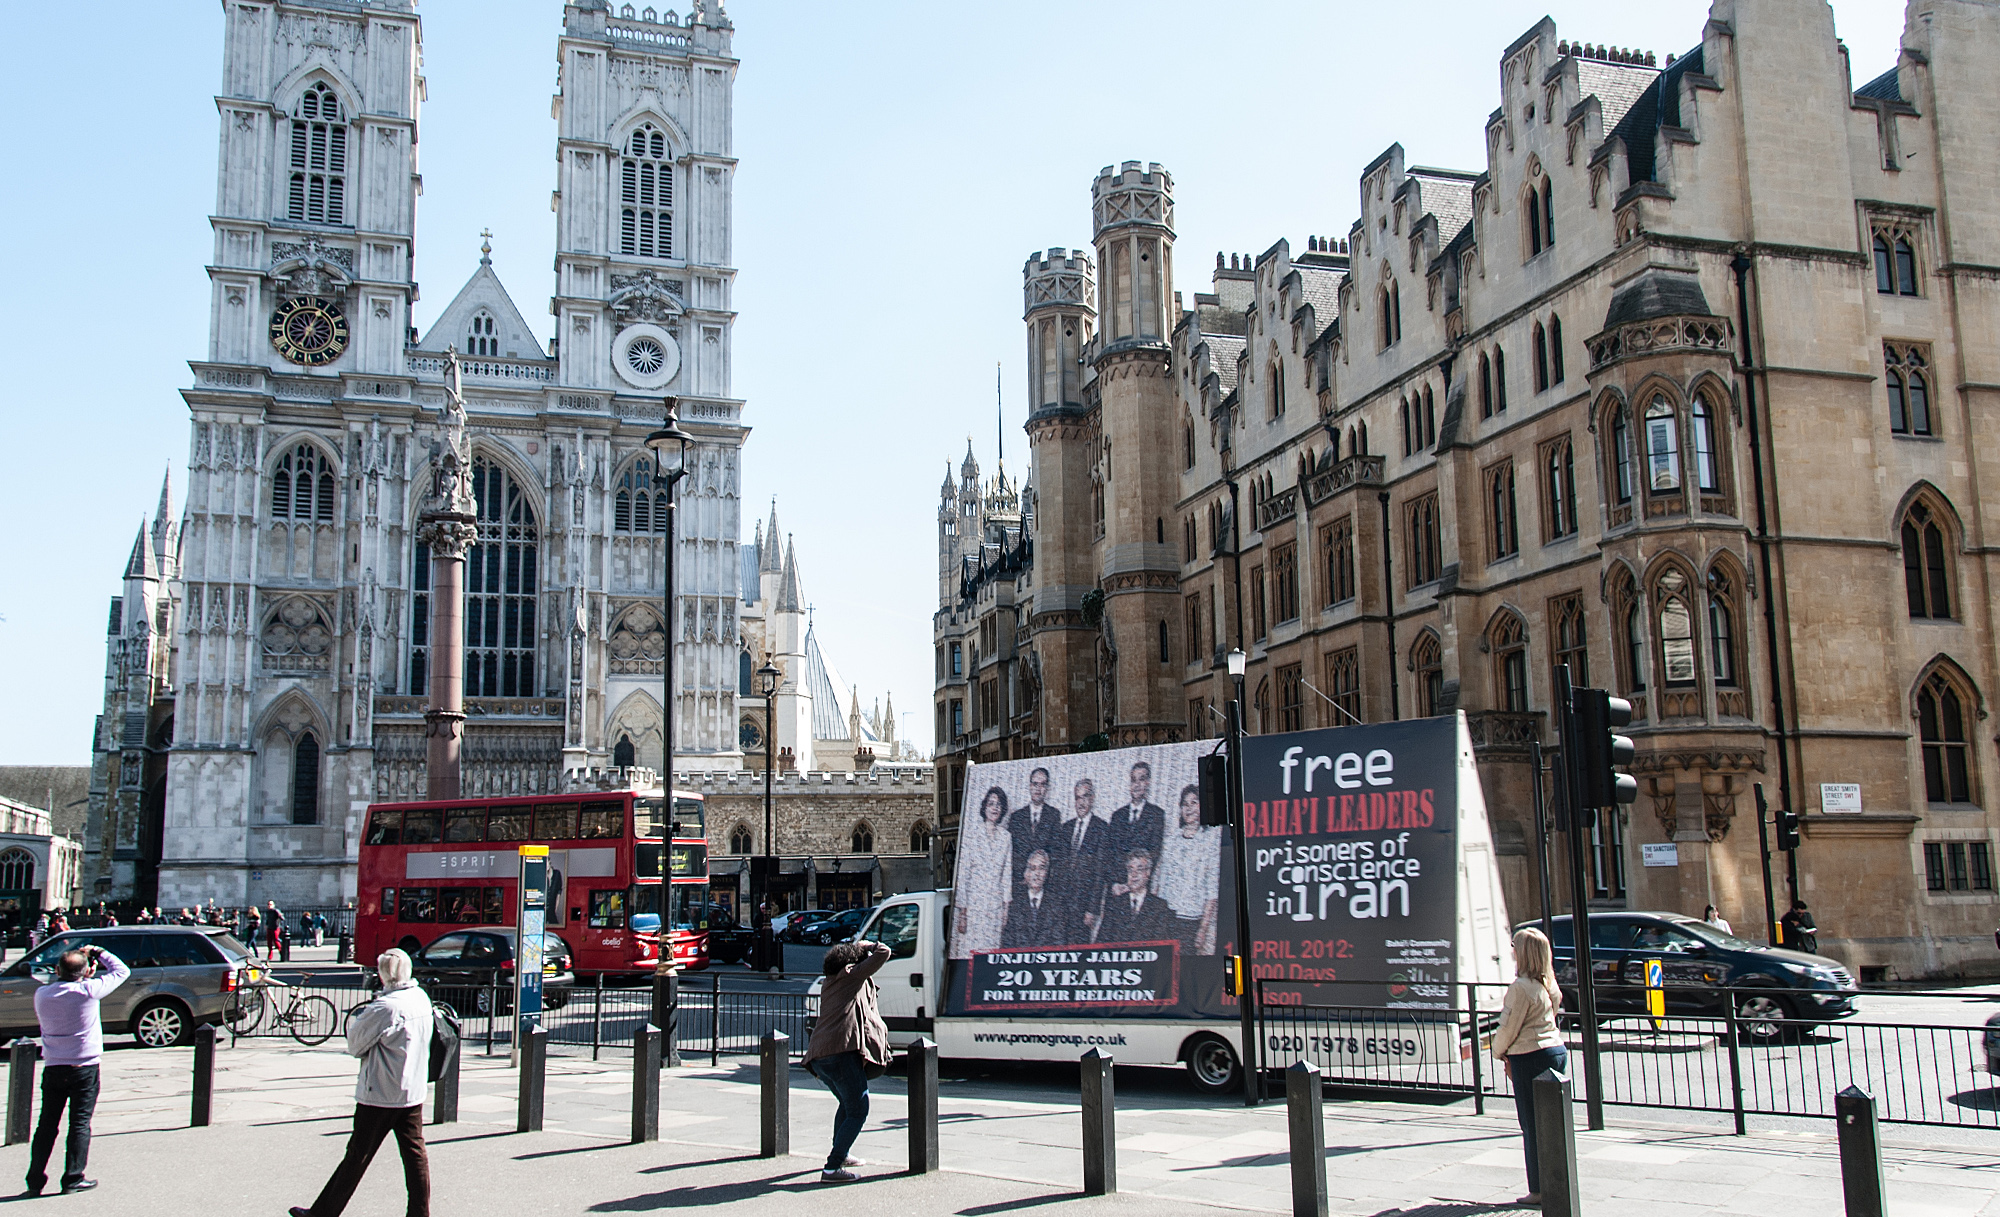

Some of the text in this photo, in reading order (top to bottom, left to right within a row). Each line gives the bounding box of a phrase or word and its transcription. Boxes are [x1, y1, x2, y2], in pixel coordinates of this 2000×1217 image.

[1280, 746, 1393, 794] free
[1326, 789, 1434, 832] LEADERS
[441, 856, 495, 867] ESPRIT
[1256, 832, 1410, 872] prisoners of
[1277, 858, 1420, 884] conscience
[1266, 879, 1409, 921] in iran
[1252, 941, 1296, 958] PRIL
[1301, 939, 1354, 958] 2012:
[1409, 939, 1451, 948] Community
[987, 950, 1158, 965] UNJUSTLY JAILED
[997, 969, 1142, 986] 20 YEARS
[1289, 964, 1336, 987] Days
[983, 989, 1155, 1001] FOR THEIR RELIGION
[974, 1032, 1127, 1046] www.promogroup.co.uk
[1269, 1036, 1416, 1056] 020 7978 6399
